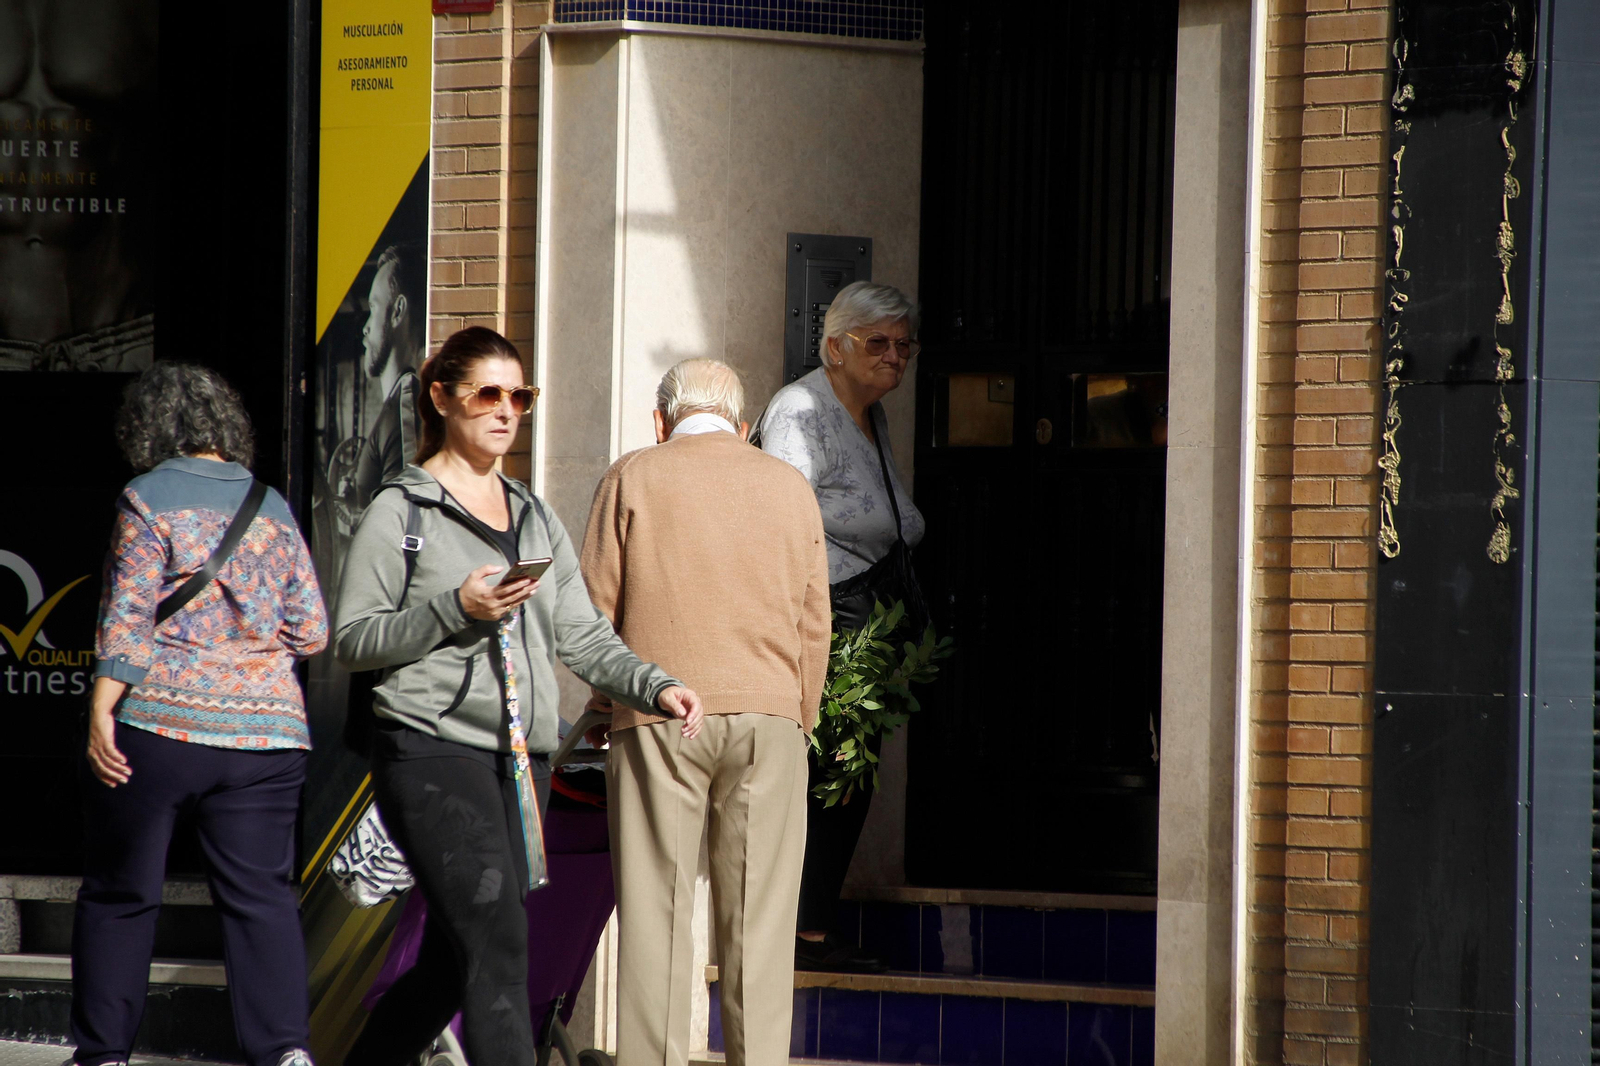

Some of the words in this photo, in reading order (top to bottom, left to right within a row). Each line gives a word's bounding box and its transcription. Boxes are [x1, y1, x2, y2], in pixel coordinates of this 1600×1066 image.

[343, 20, 404, 38] MUSCULACIÓN
[337, 55, 408, 71] ASESORAMIENTO
[350, 77, 394, 92] PERSONAL
[0, 118, 93, 133] ICAMENTE
[1, 139, 80, 158] UERTE
[27, 649, 95, 667] QUALIT
[3, 665, 94, 695] tnes
